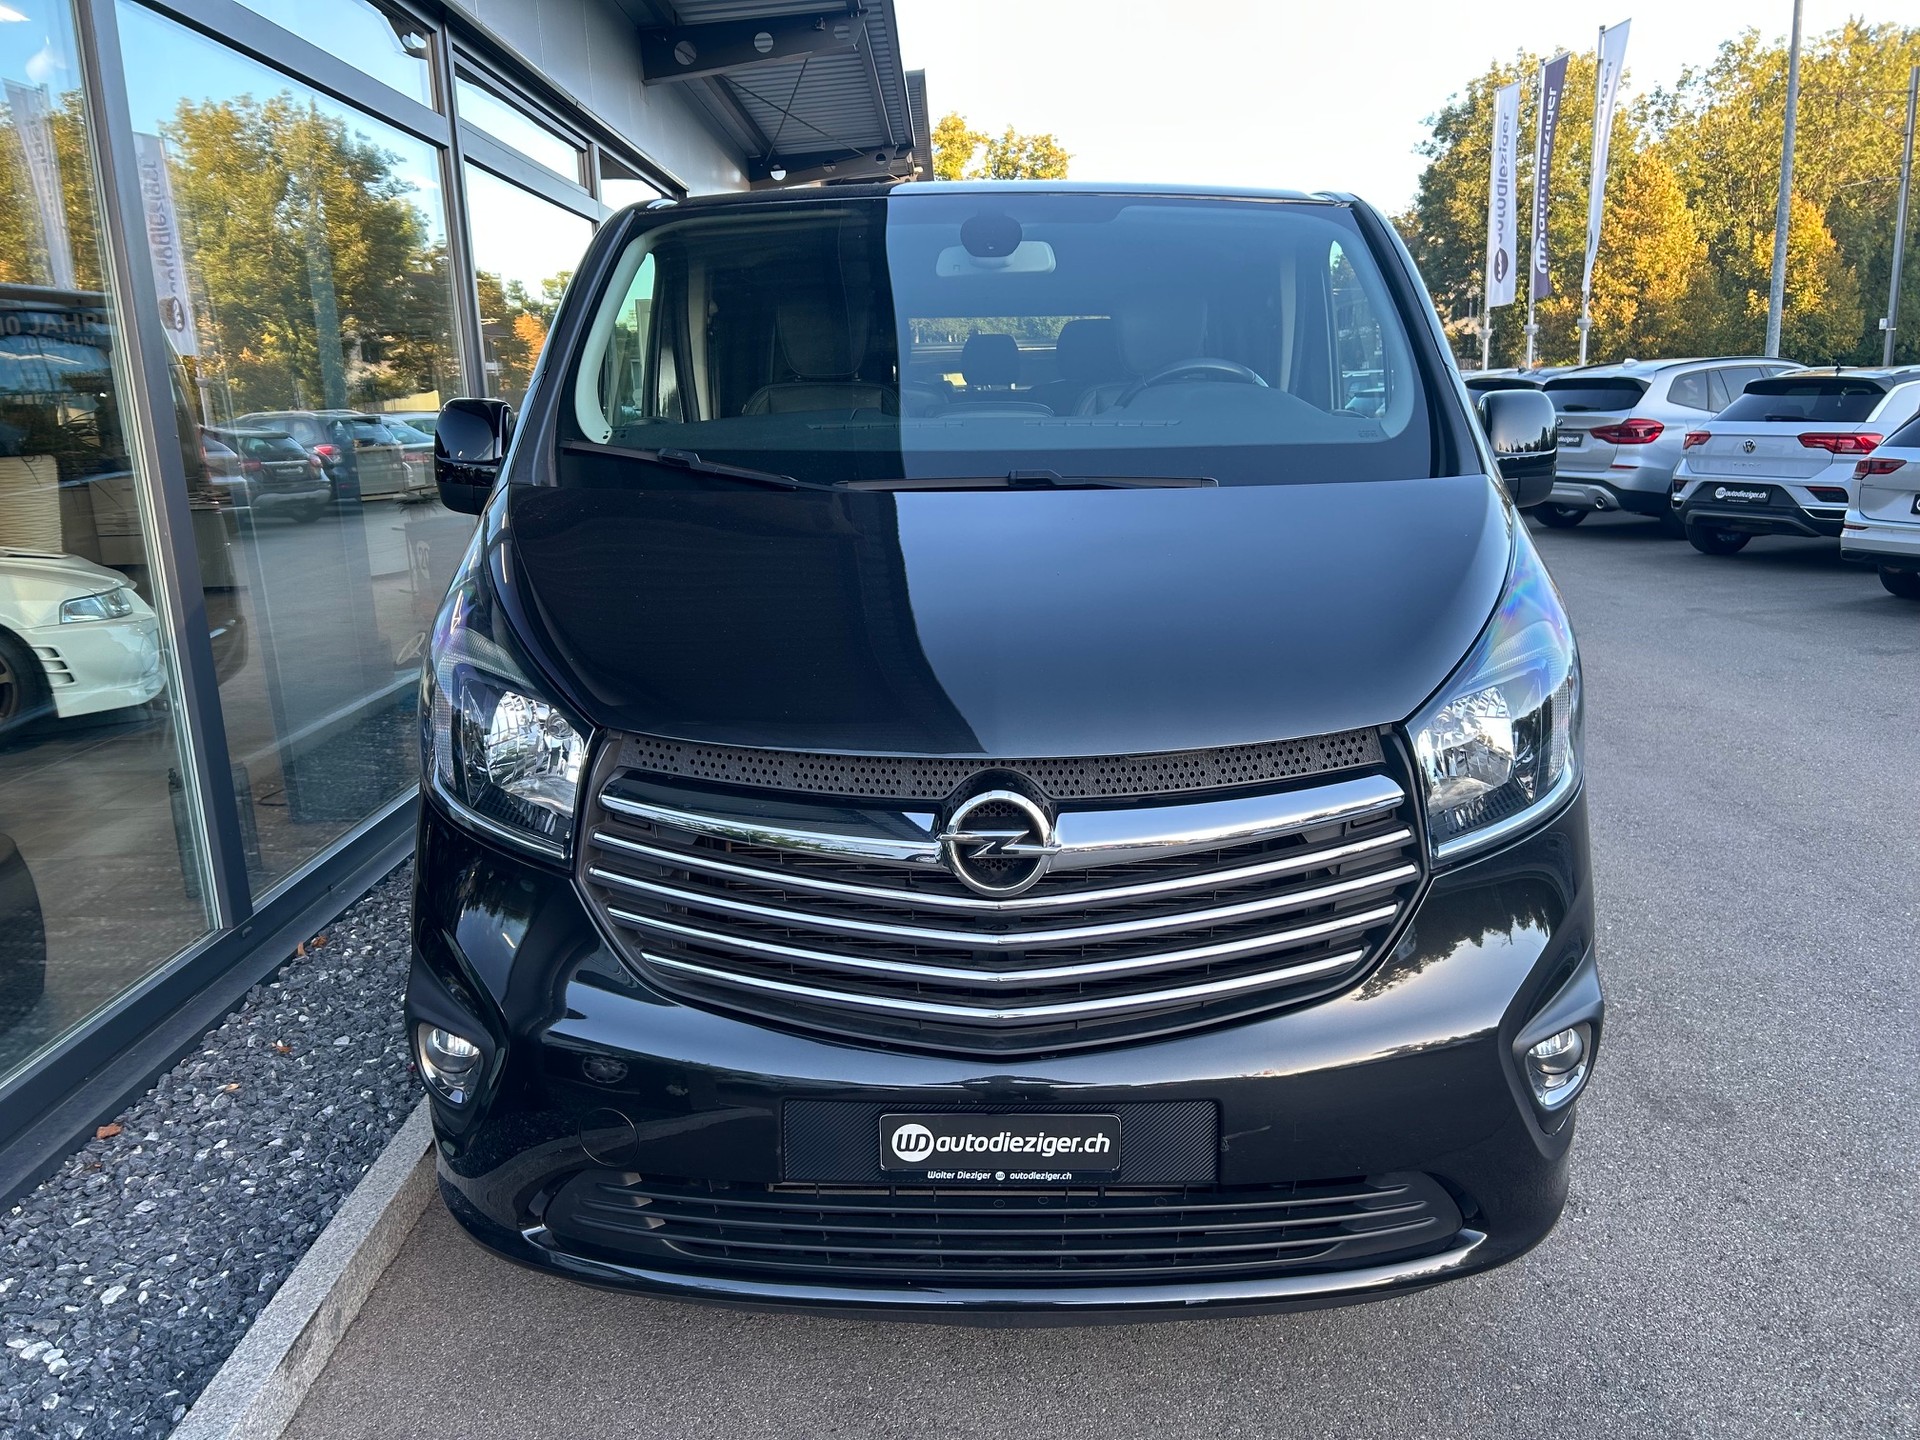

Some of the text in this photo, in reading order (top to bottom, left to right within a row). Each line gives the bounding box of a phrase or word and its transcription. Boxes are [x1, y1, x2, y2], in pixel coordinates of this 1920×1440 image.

[966, 792, 1031, 808] OPEL
[936, 1132, 1111, 1157] autodieziger.ch
[927, 1171, 956, 1179] Walter
[957, 1171, 991, 1181] Dieziger
[1009, 1171, 1073, 1181] autodieziger.ch
